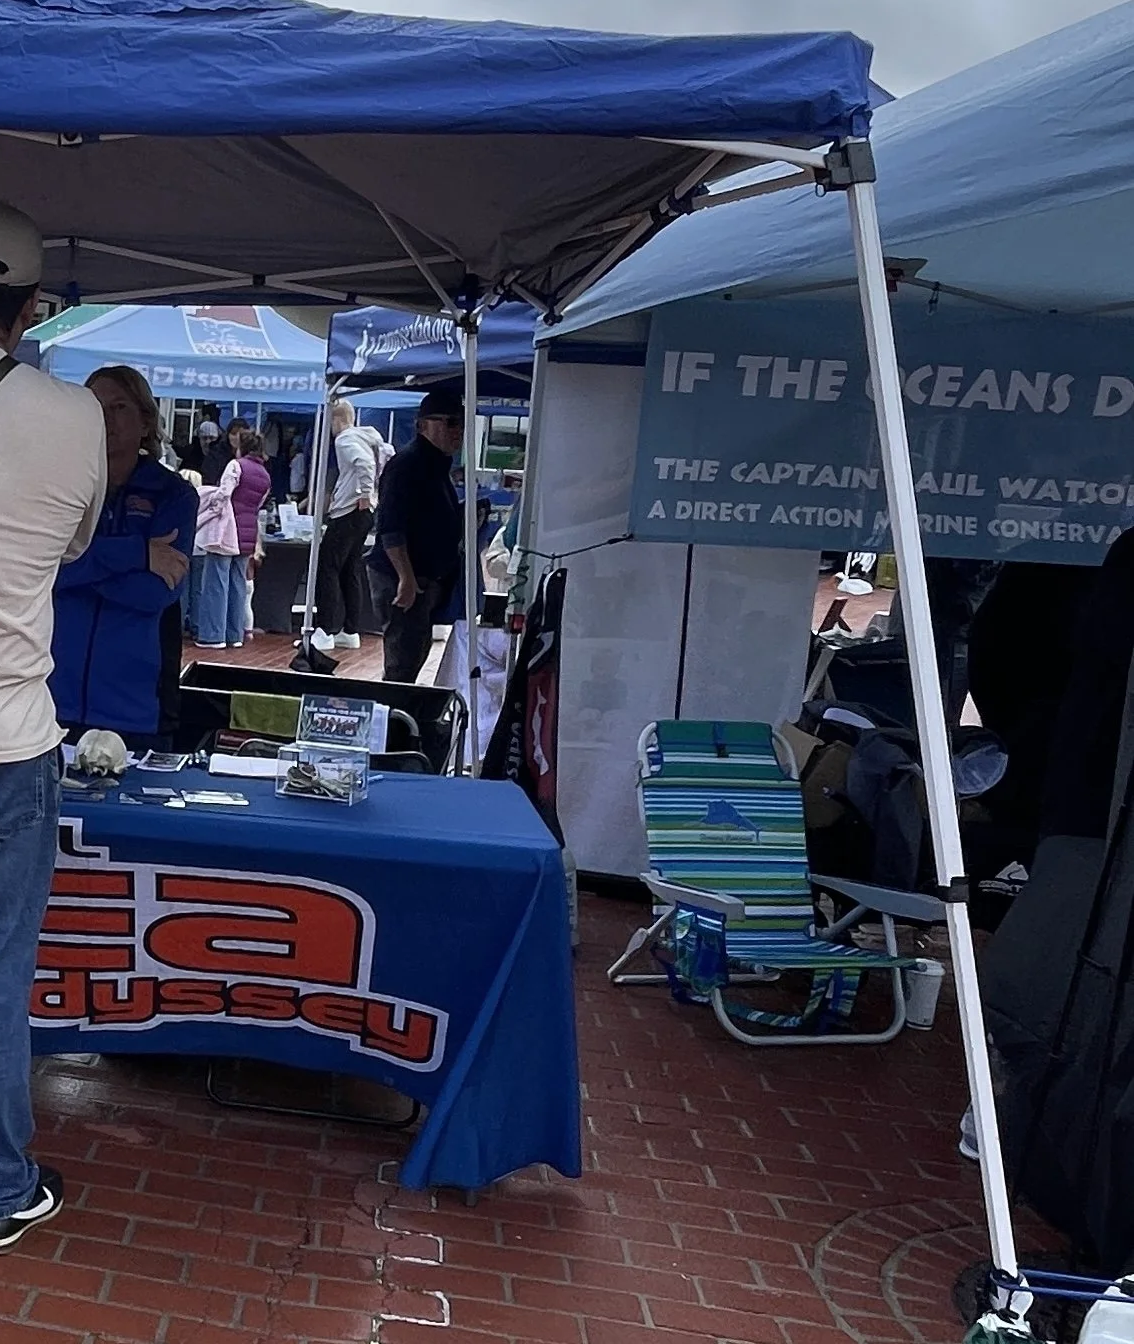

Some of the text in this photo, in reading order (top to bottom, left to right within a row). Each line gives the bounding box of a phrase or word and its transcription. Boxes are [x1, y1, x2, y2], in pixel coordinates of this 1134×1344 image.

[662, 351, 715, 393] IF
[736, 355, 848, 401] THE
[653, 457, 720, 482] THE
[730, 461, 879, 490] CAPTAIN
[914, 471, 985, 497] AUL
[647, 500, 666, 520] A
[674, 501, 761, 523] DIRECT
[770, 504, 863, 529] ACTION
[873, 509, 978, 537] MRINE
